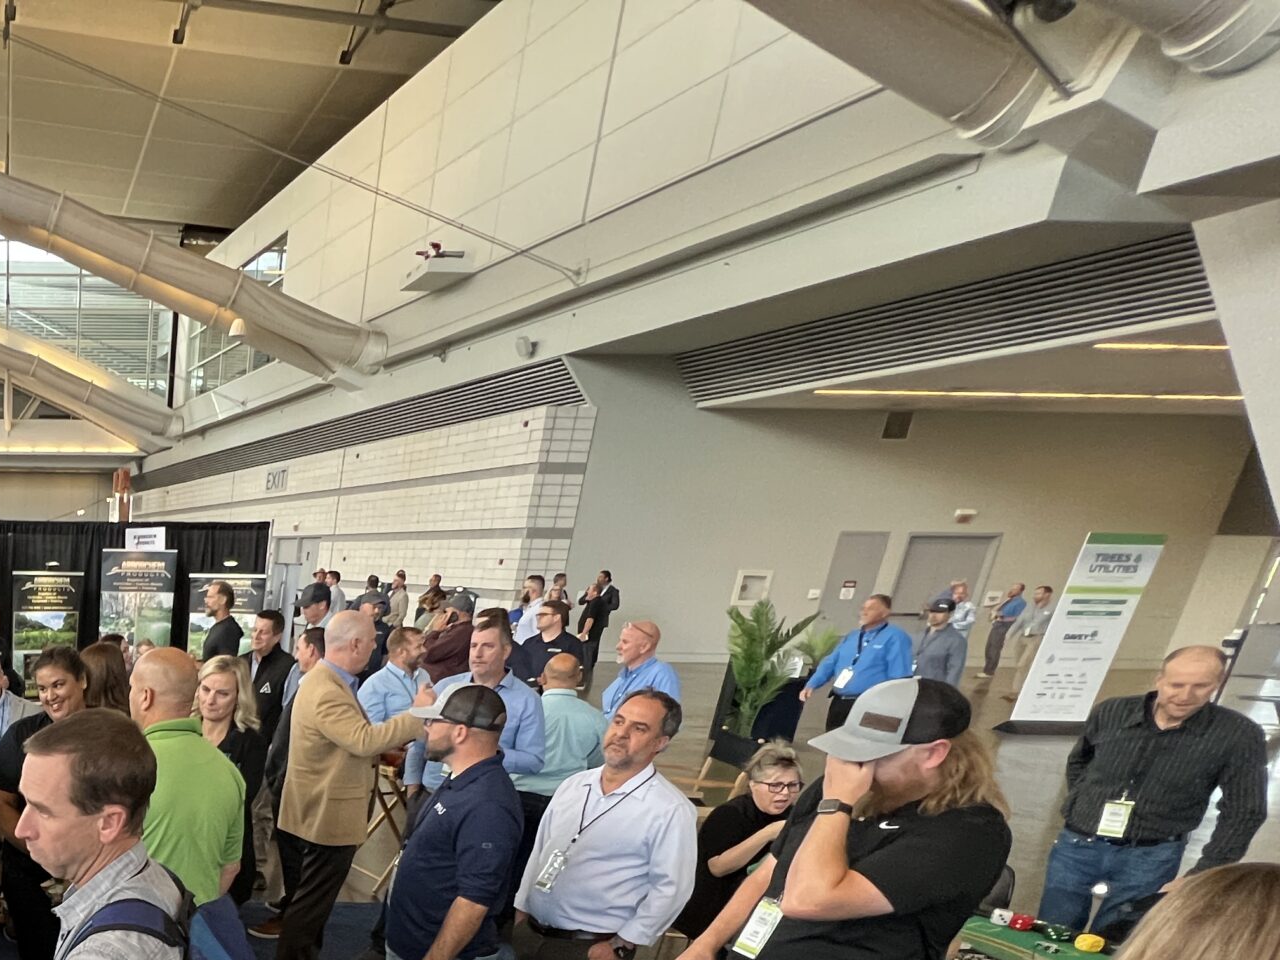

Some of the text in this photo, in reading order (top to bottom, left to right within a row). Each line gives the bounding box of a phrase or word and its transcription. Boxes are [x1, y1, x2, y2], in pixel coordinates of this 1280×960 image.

[266, 469, 287, 491] EXIT
[1094, 552, 1132, 563] TREES
[1088, 564, 1139, 574] UTILITIES
[1062, 632, 1089, 641] DAVEY
